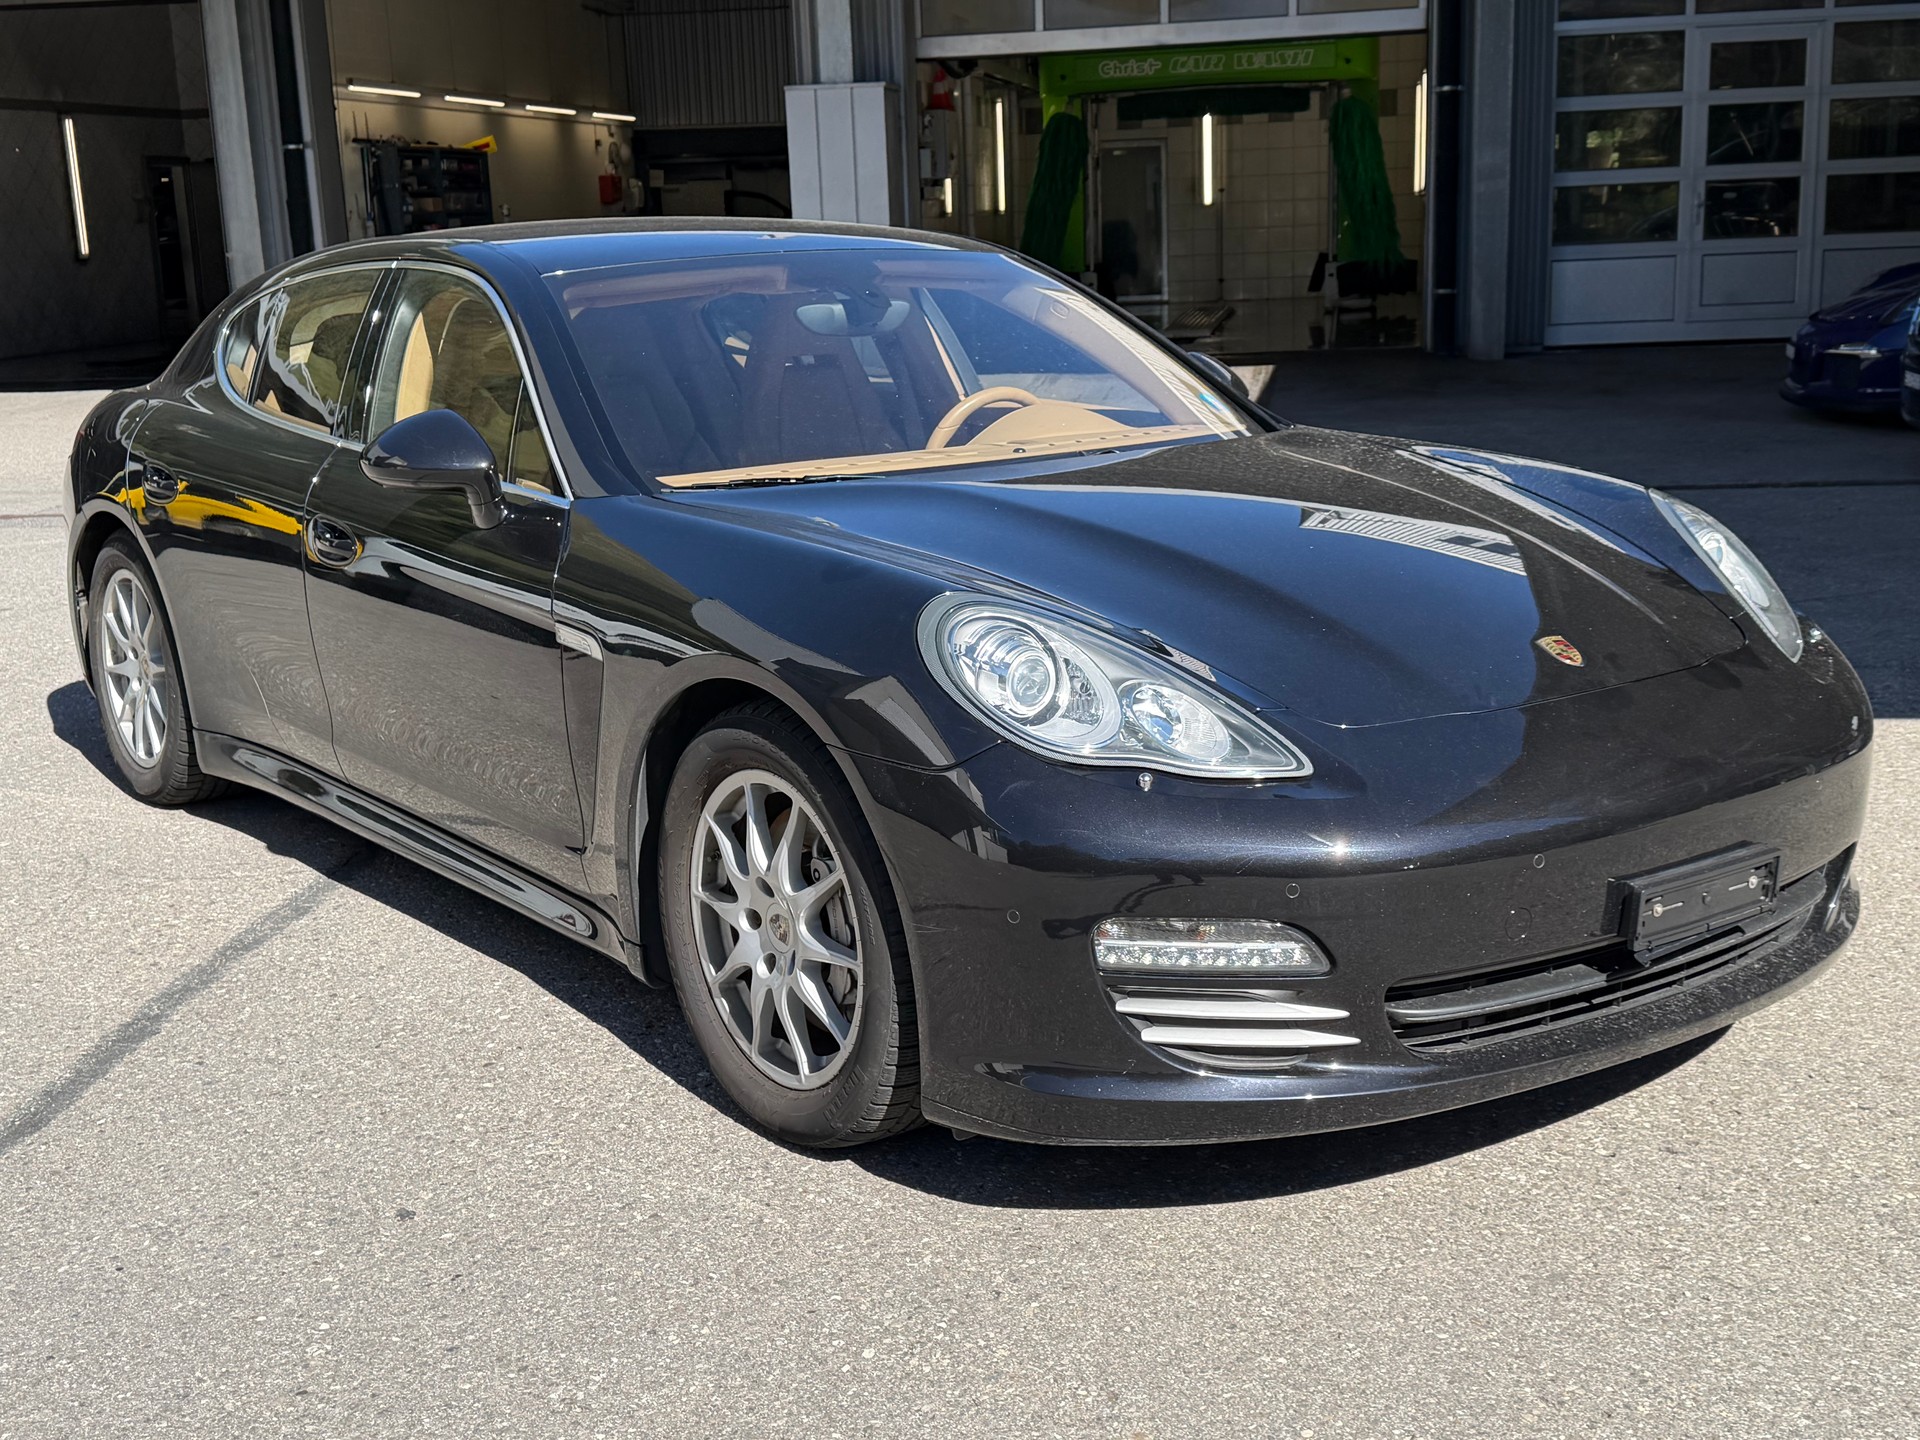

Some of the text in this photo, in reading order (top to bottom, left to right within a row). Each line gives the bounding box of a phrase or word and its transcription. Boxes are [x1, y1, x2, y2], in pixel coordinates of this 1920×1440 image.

[1099, 48, 1315, 78] Christ CAR WASH
[860, 886, 876, 946] OUTSIDE
